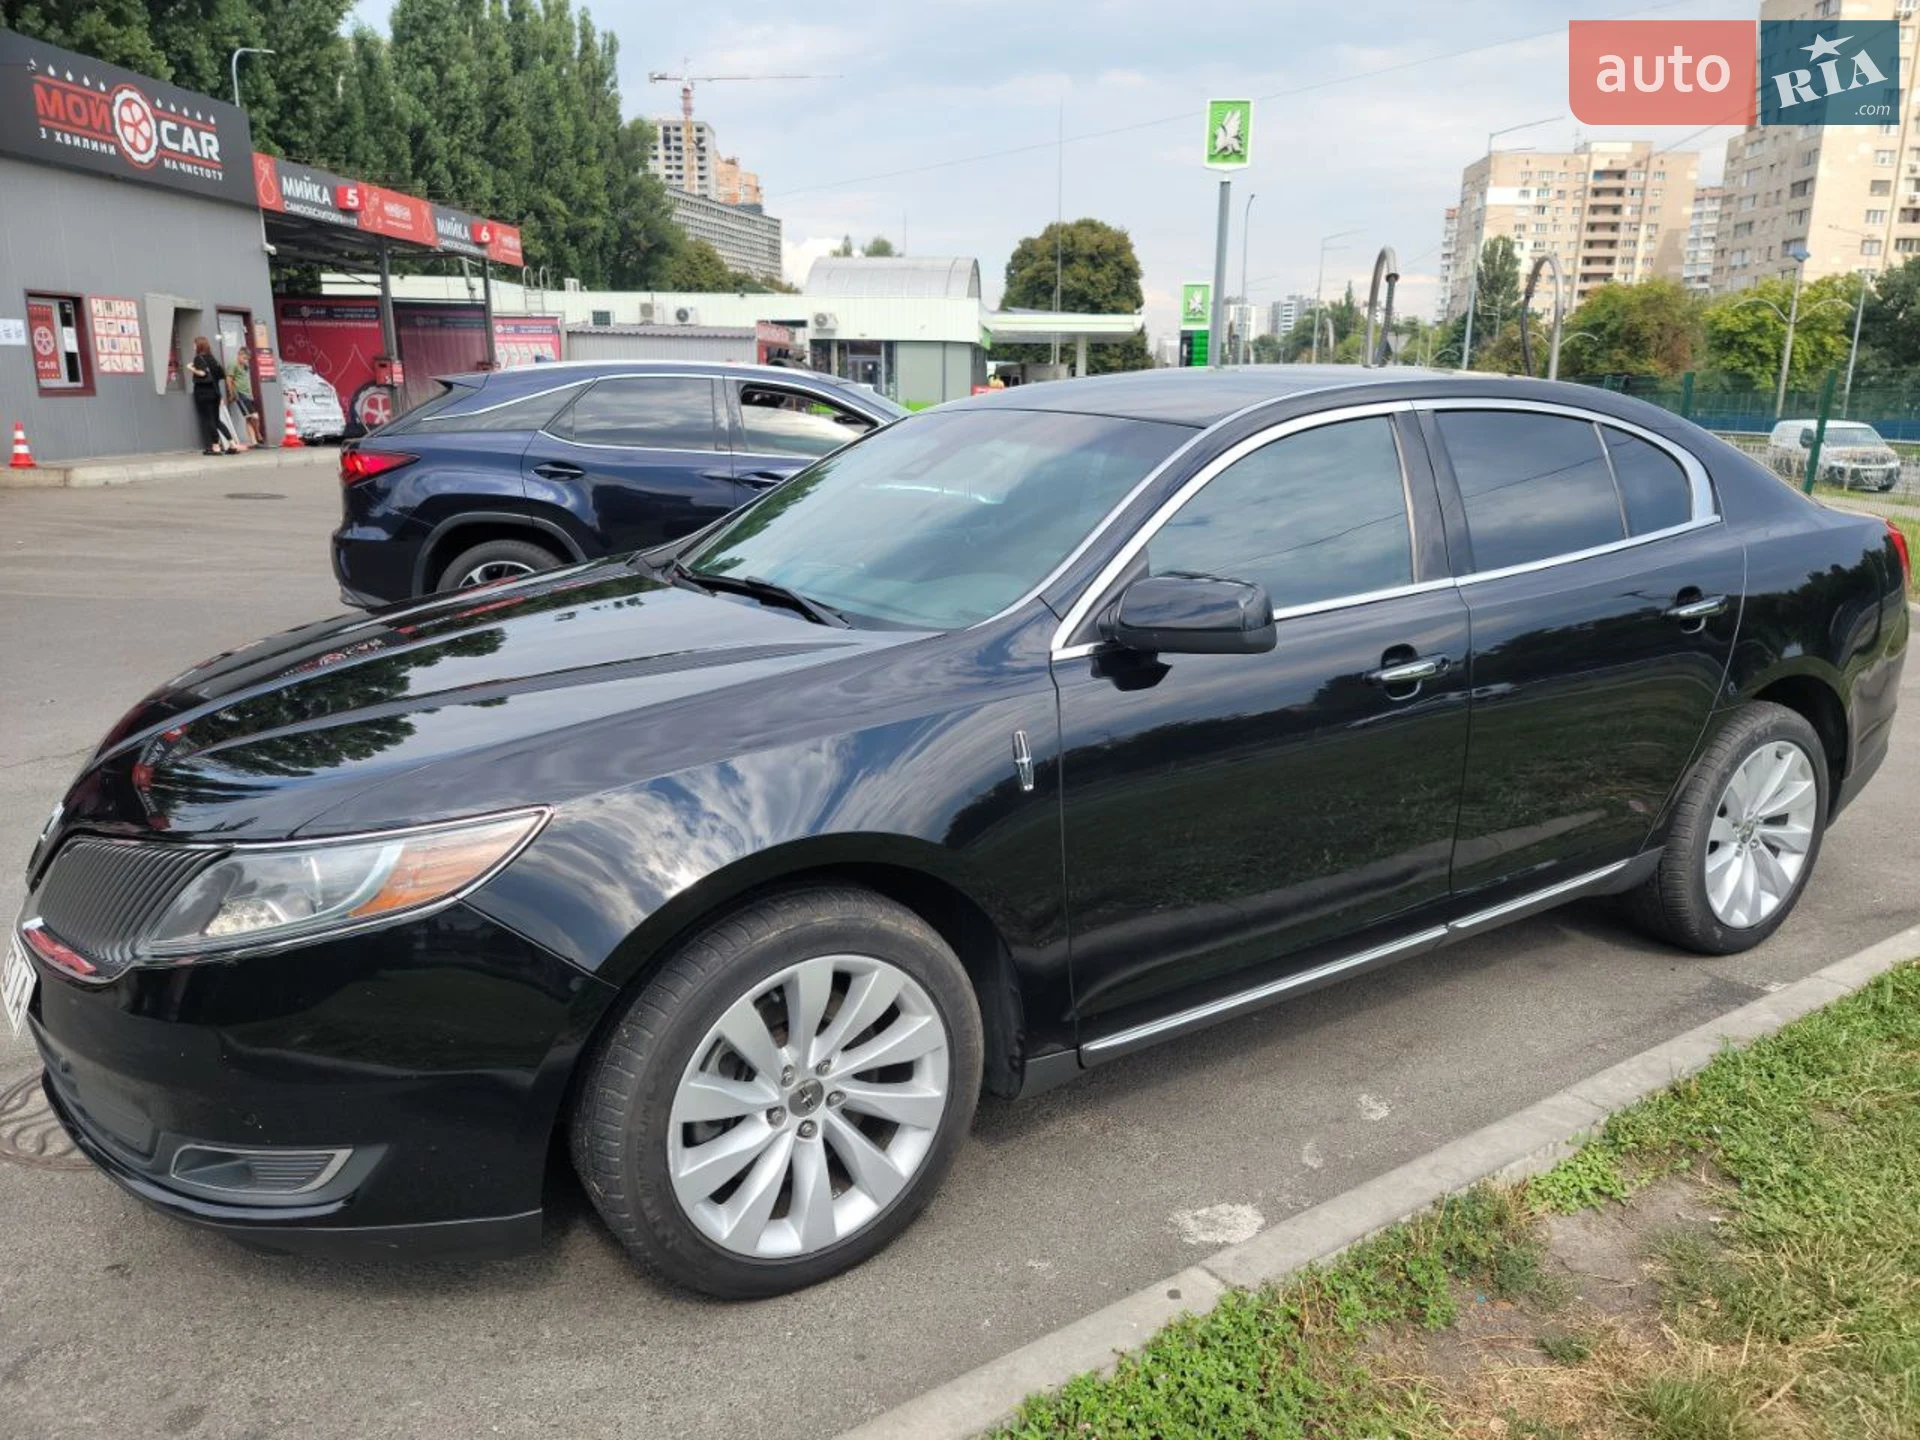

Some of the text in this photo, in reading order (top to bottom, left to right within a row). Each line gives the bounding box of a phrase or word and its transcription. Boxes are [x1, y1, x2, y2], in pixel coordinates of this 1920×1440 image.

[160, 119, 221, 162] CAR
[282, 174, 359, 207] МИЙКА 5
[437, 216, 470, 241] МИЙКА
[481, 225, 491, 242] 6
[37, 360, 58, 370] CAR
